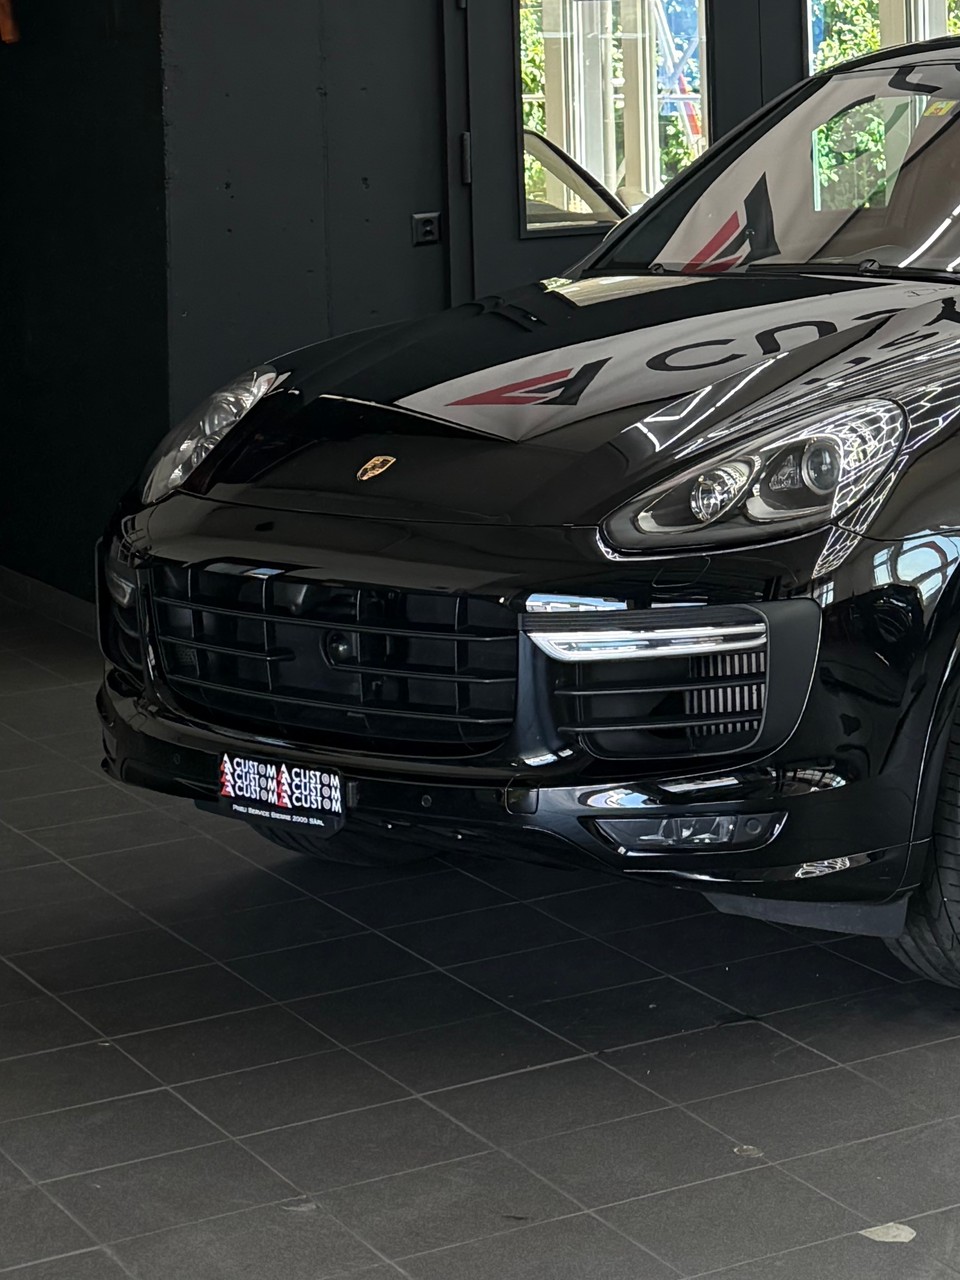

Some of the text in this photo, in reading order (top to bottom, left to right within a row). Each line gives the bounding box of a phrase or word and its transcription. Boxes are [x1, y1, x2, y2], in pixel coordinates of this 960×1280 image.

[234, 758, 276, 778] CUSTOM
[292, 768, 339, 787] CUSTOM
[234, 771, 277, 791] CUSTOM
[292, 781, 340, 801] CUSTOM
[235, 784, 278, 804] CUSTOM
[292, 794, 342, 813] CUSTOM
